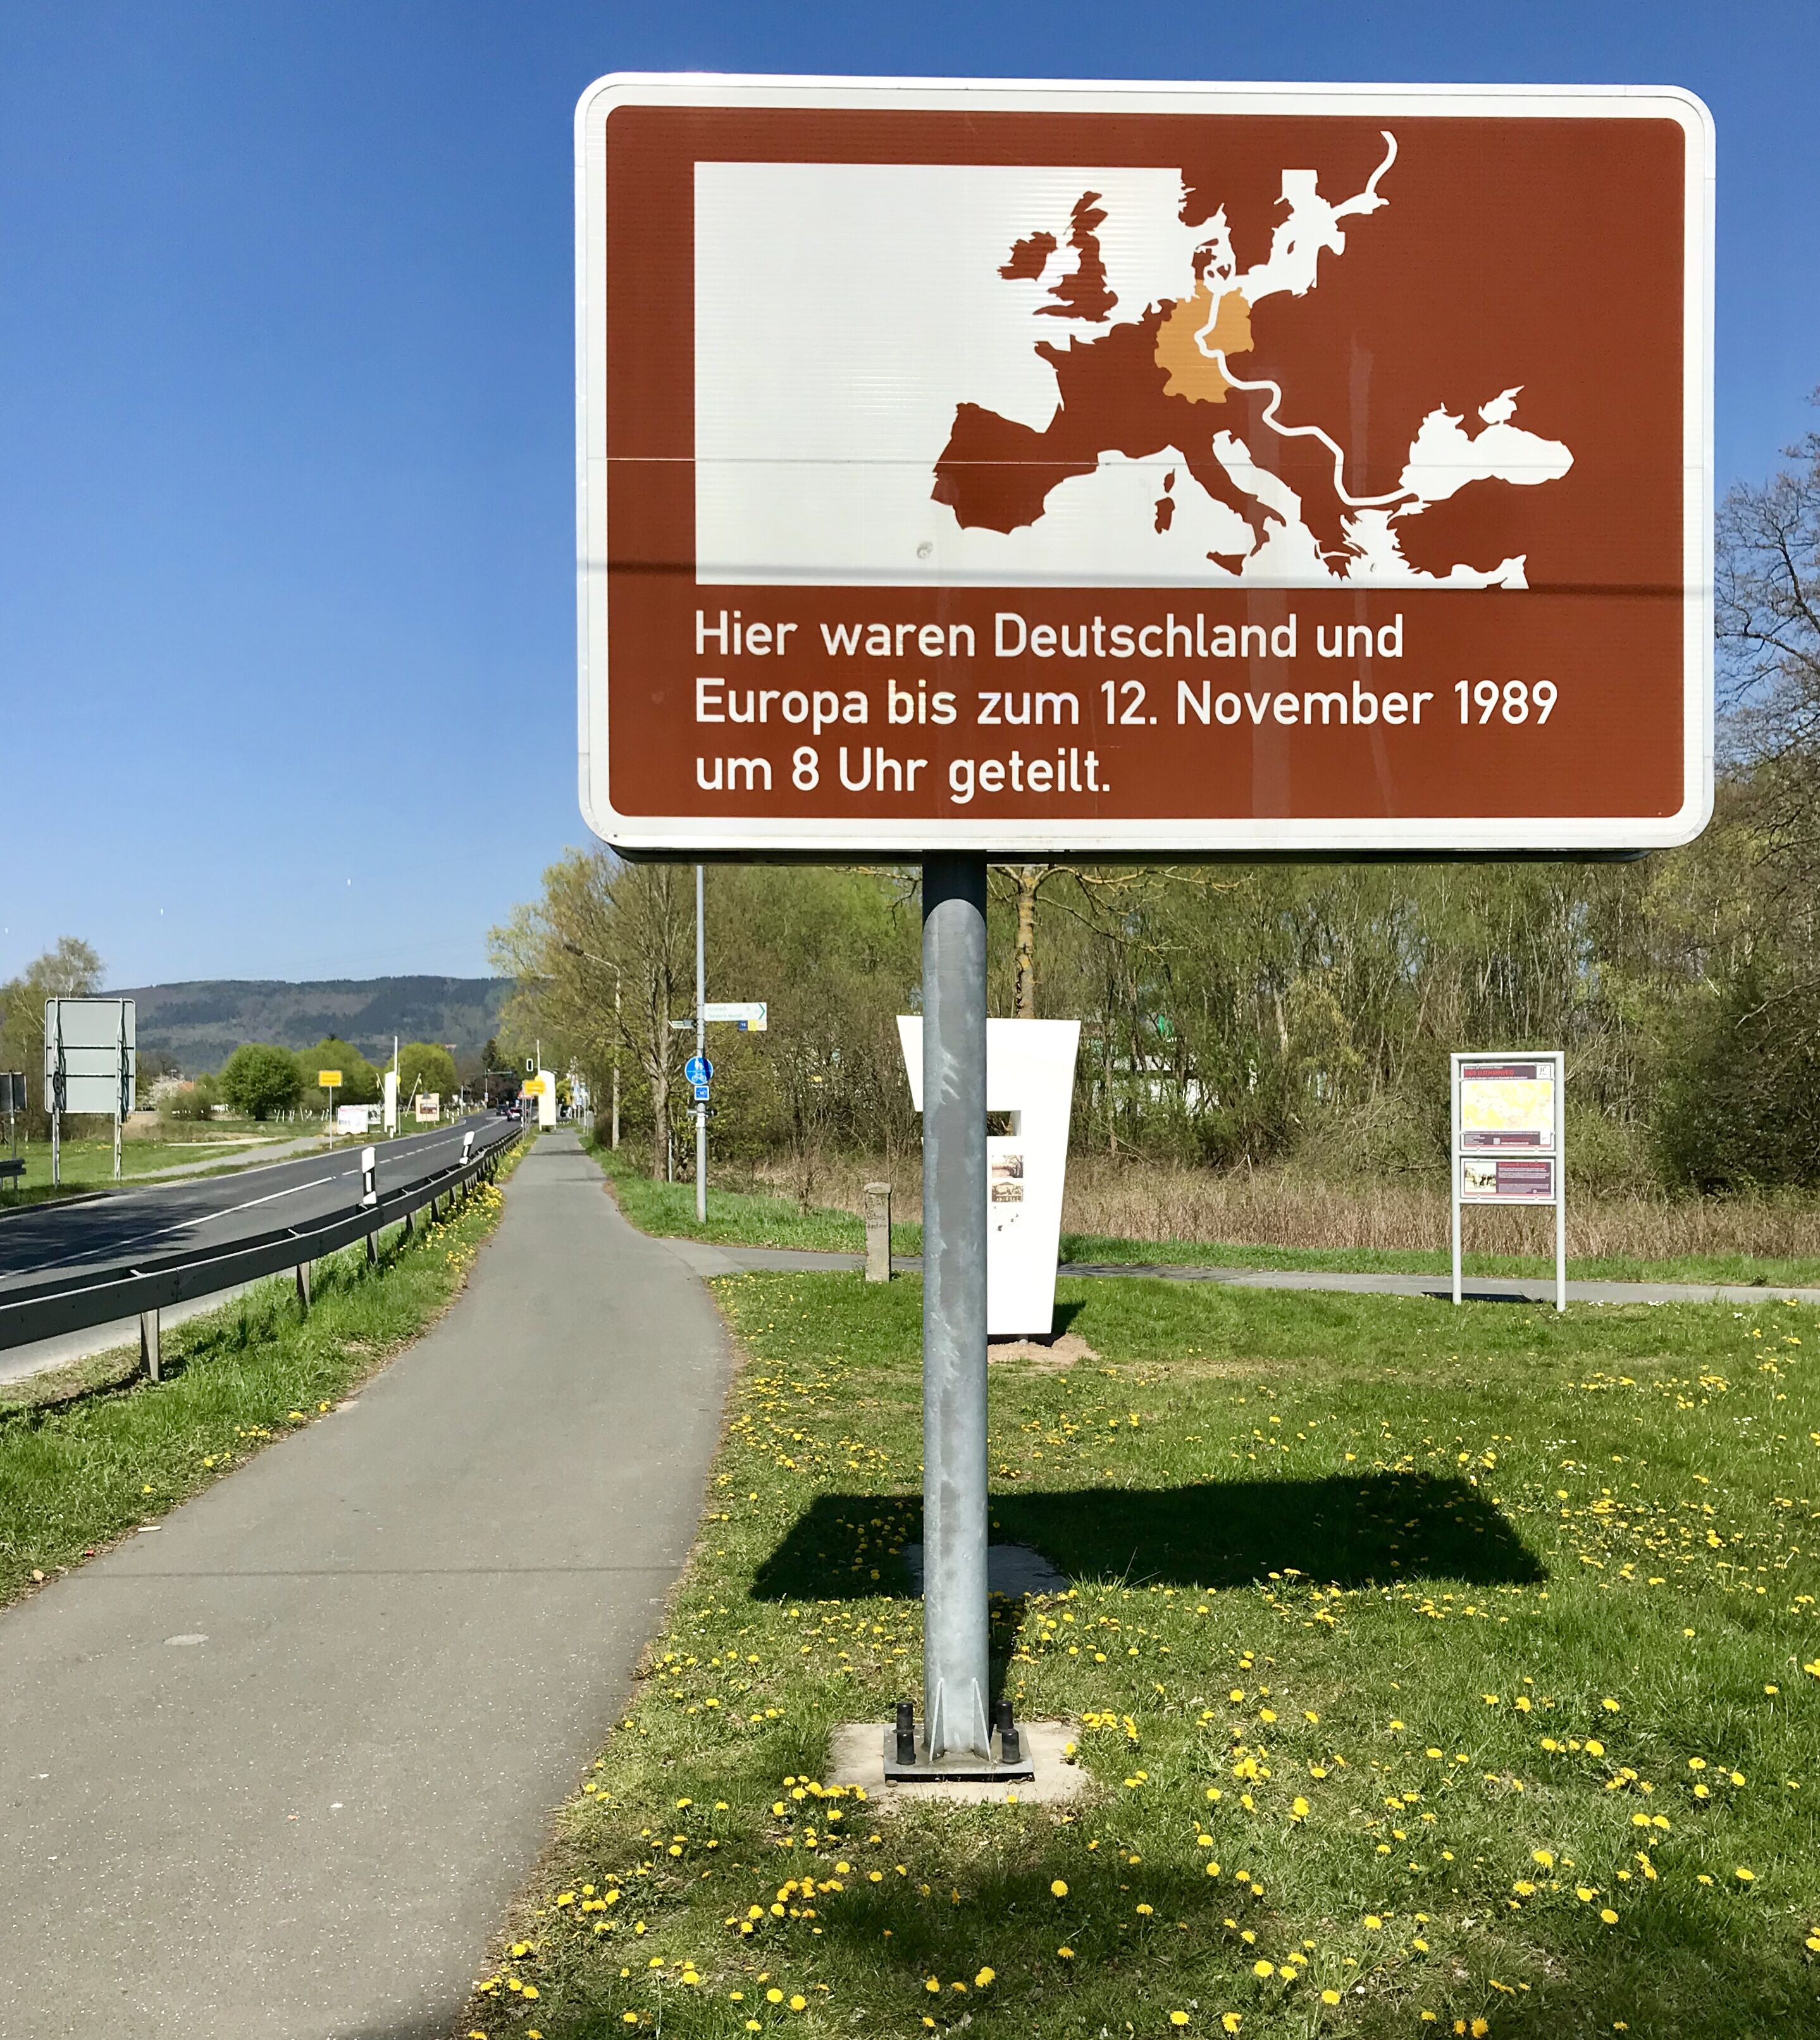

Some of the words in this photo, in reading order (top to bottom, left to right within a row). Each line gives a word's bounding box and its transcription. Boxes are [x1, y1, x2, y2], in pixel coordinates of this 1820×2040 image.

[695, 609, 799, 656] Hier
[820, 623, 975, 658] waren
[994, 612, 1297, 658] Deutschland
[1316, 613, 1404, 658] und
[695, 677, 869, 736] Europa
[888, 679, 958, 726] bis
[977, 691, 1079, 726] zum
[1100, 679, 1158, 726] 12.
[1177, 679, 1435, 726] November
[1454, 679, 1558, 725] 1989
[696, 757, 772, 791] um
[791, 745, 820, 791] 8
[839, 746, 929, 792] Uhr
[948, 747, 1111, 804] geteilt.
